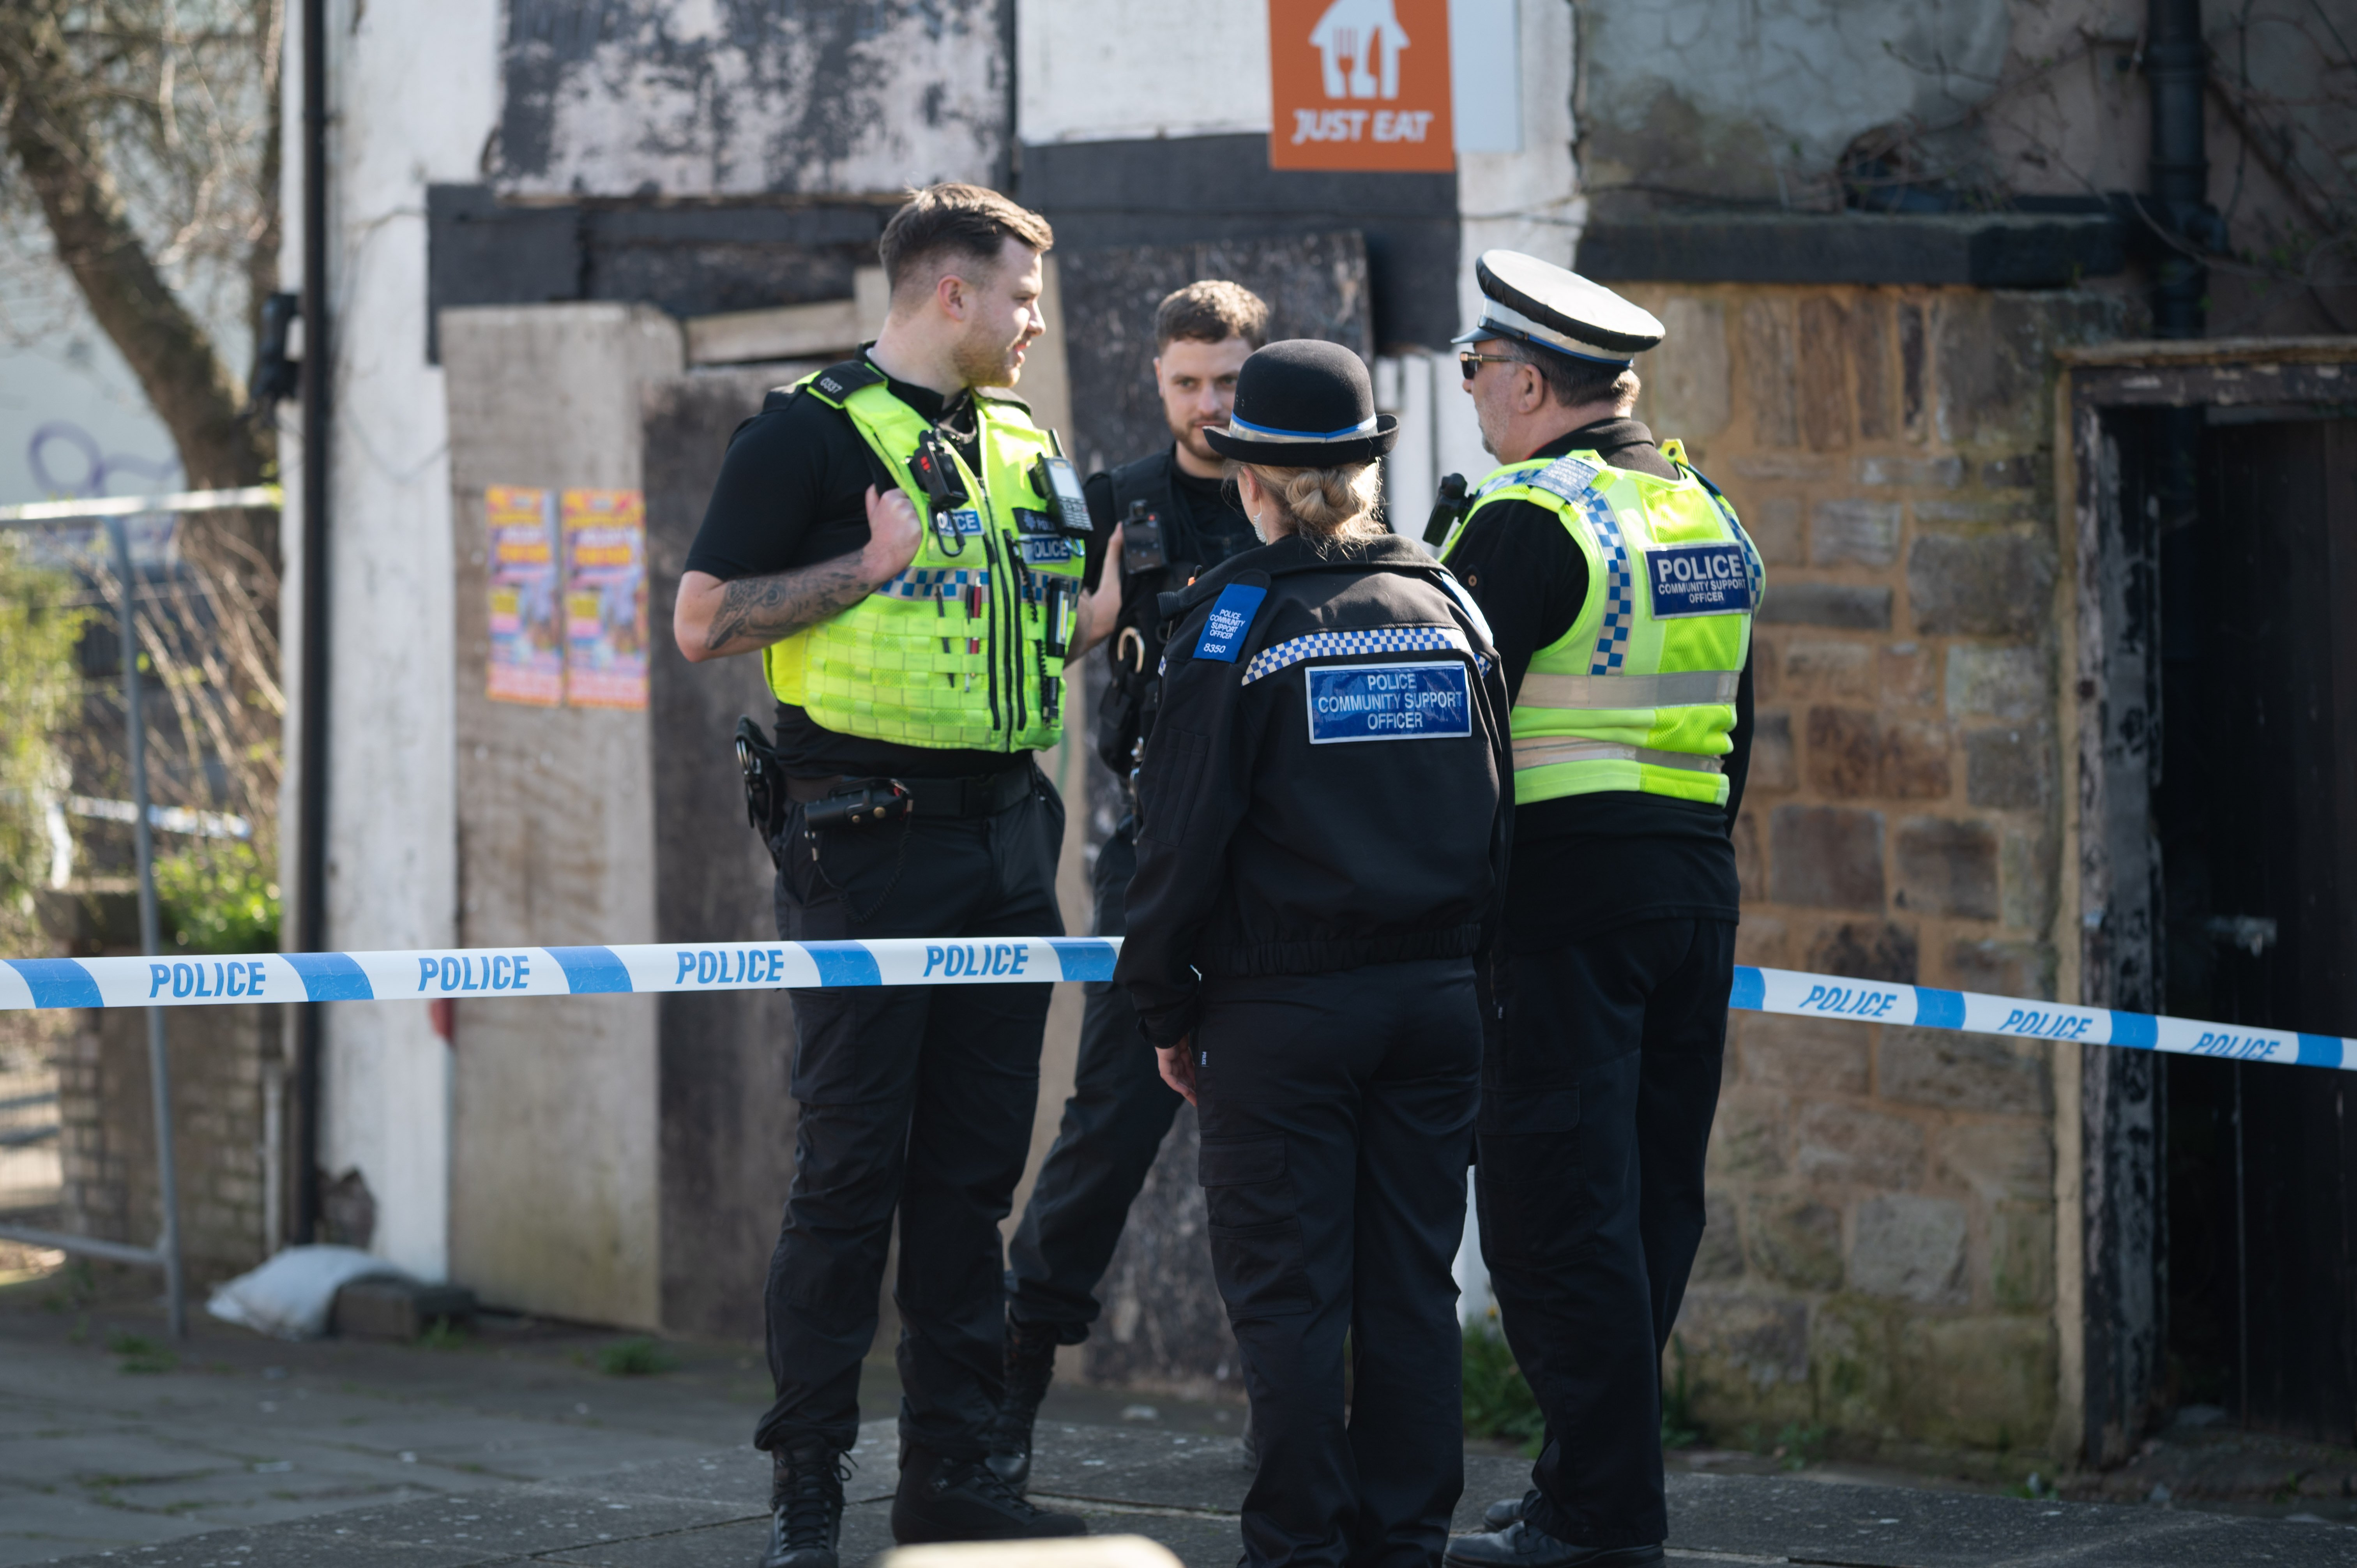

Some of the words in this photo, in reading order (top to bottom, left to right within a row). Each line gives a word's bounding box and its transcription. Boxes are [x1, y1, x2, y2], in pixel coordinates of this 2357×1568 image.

[1291, 109, 1370, 146] JUST
[1371, 110, 1435, 142] EAT
[1034, 539, 1069, 558] OLICE
[1657, 554, 1744, 583] POLICE
[1659, 580, 1709, 595] COMMUNITY
[1710, 578, 1746, 591] SUPPORT
[1689, 592, 1724, 603] OFFICER
[1210, 614, 1246, 627] COMMUNITY
[1219, 609, 1241, 620] POLICE
[1210, 629, 1233, 639] OFFICER
[1211, 622, 1238, 633] SUPPORT
[1203, 643, 1226, 653] 8350
[1368, 673, 1417, 690] POLICE
[1318, 693, 1401, 713] COMMUNITY
[1405, 691, 1463, 708] SUPPORT
[1368, 712, 1423, 730] OFFICER
[675, 950, 784, 984] POLICE
[923, 944, 1028, 977] POLICE
[149, 962, 265, 998] POLICE
[418, 955, 530, 991] POLICE
[1798, 985, 1898, 1017] POLICE
[1997, 1009, 2093, 1039] POLICE
[2187, 1032, 2280, 1061] POLICE
